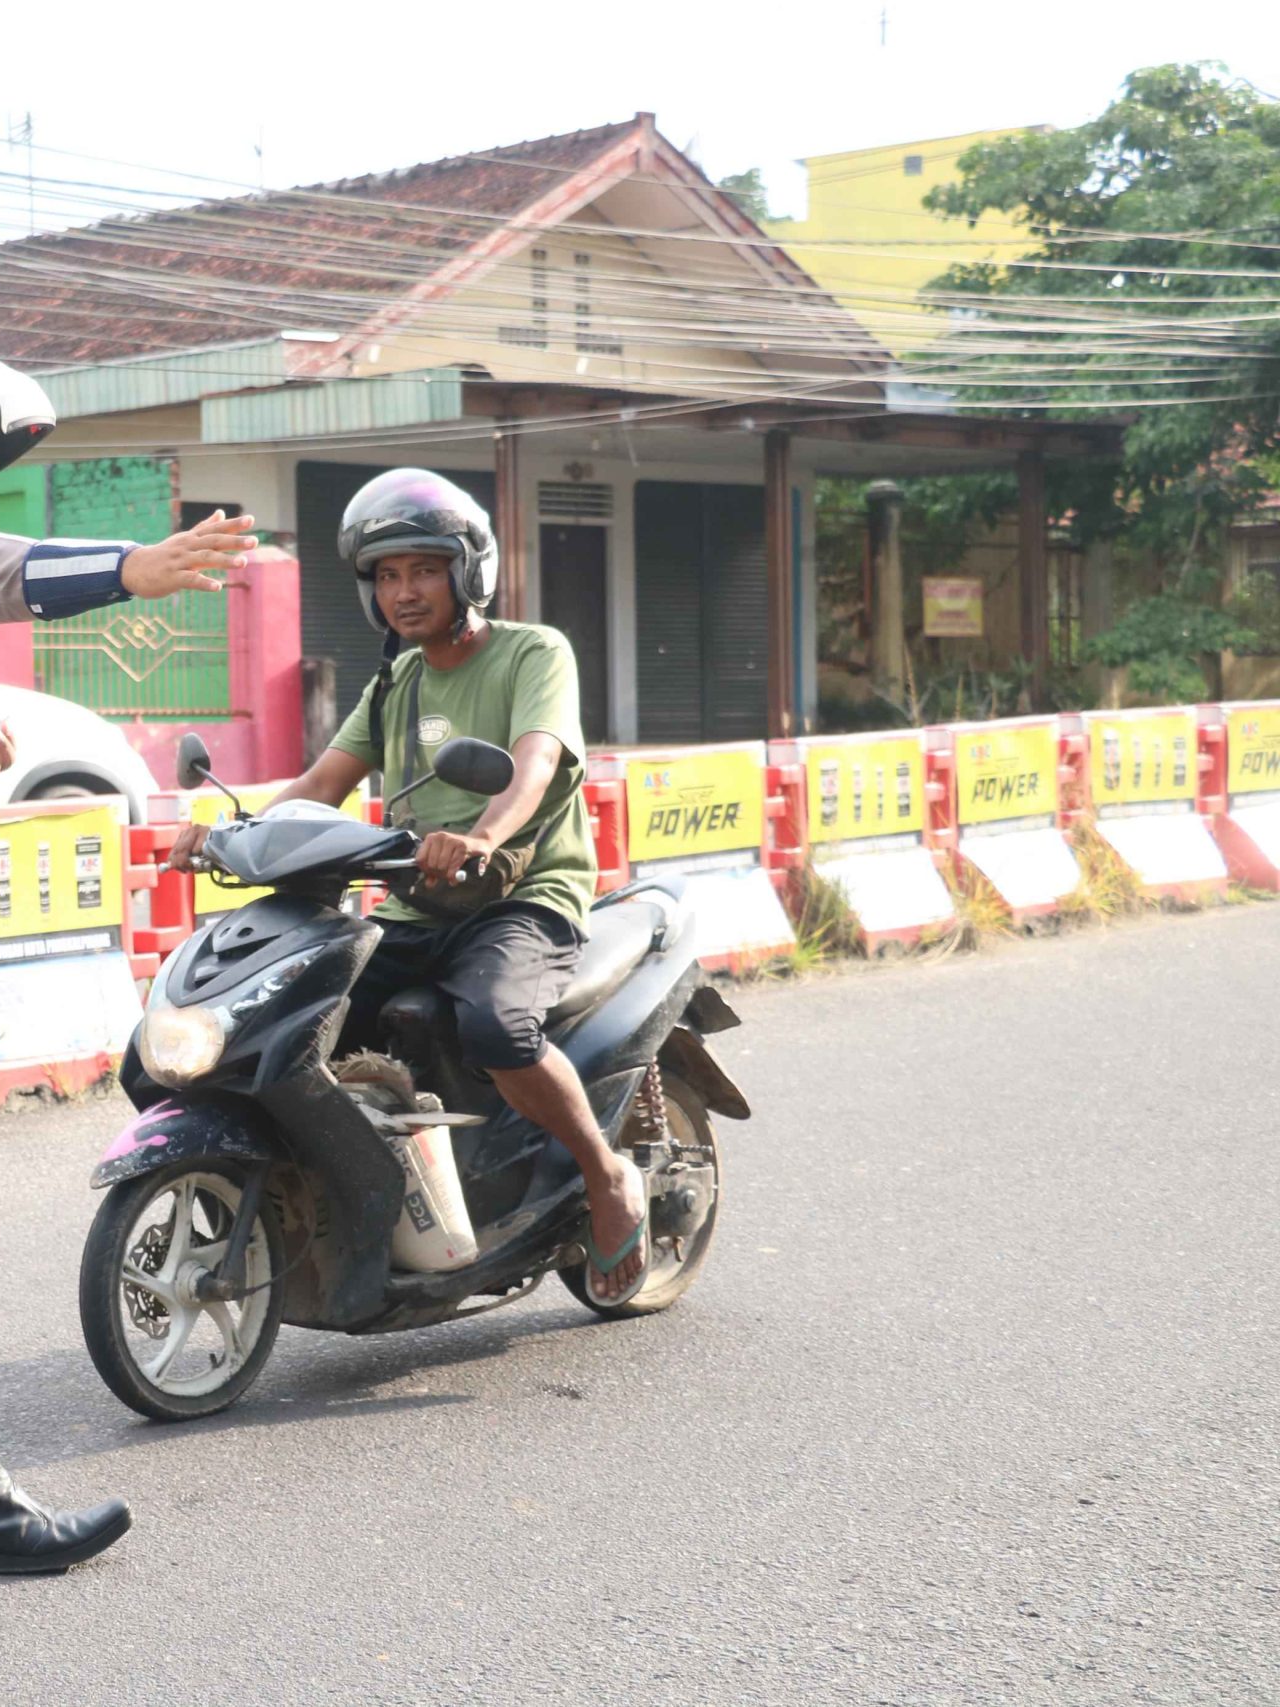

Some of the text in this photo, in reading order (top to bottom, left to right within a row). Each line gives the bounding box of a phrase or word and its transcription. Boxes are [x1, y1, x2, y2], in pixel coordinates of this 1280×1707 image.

[644, 771, 670, 788] ABC
[1239, 750, 1280, 776] POW
[971, 771, 1039, 806] POWER
[646, 801, 740, 839] POWER
[408, 1195, 431, 1228] PCC
